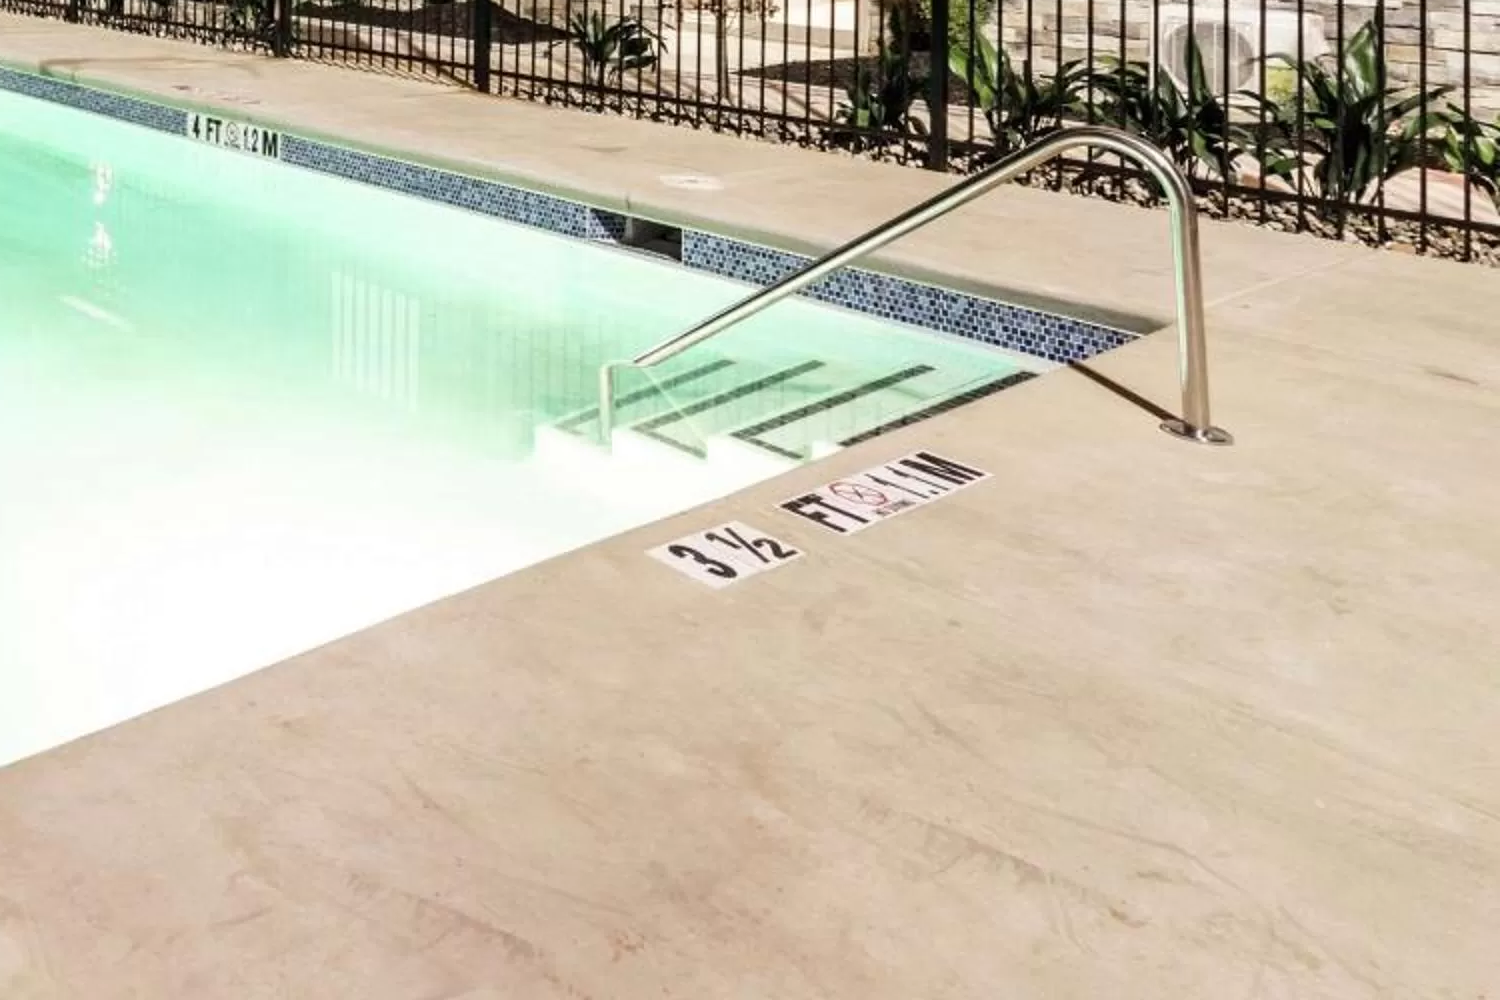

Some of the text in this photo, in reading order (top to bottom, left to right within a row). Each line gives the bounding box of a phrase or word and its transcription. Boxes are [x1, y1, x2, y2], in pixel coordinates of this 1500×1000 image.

[192, 115, 201, 139] 4
[206, 117, 223, 144] FT
[667, 544, 738, 580] 3
[779, 493, 870, 533] FT
